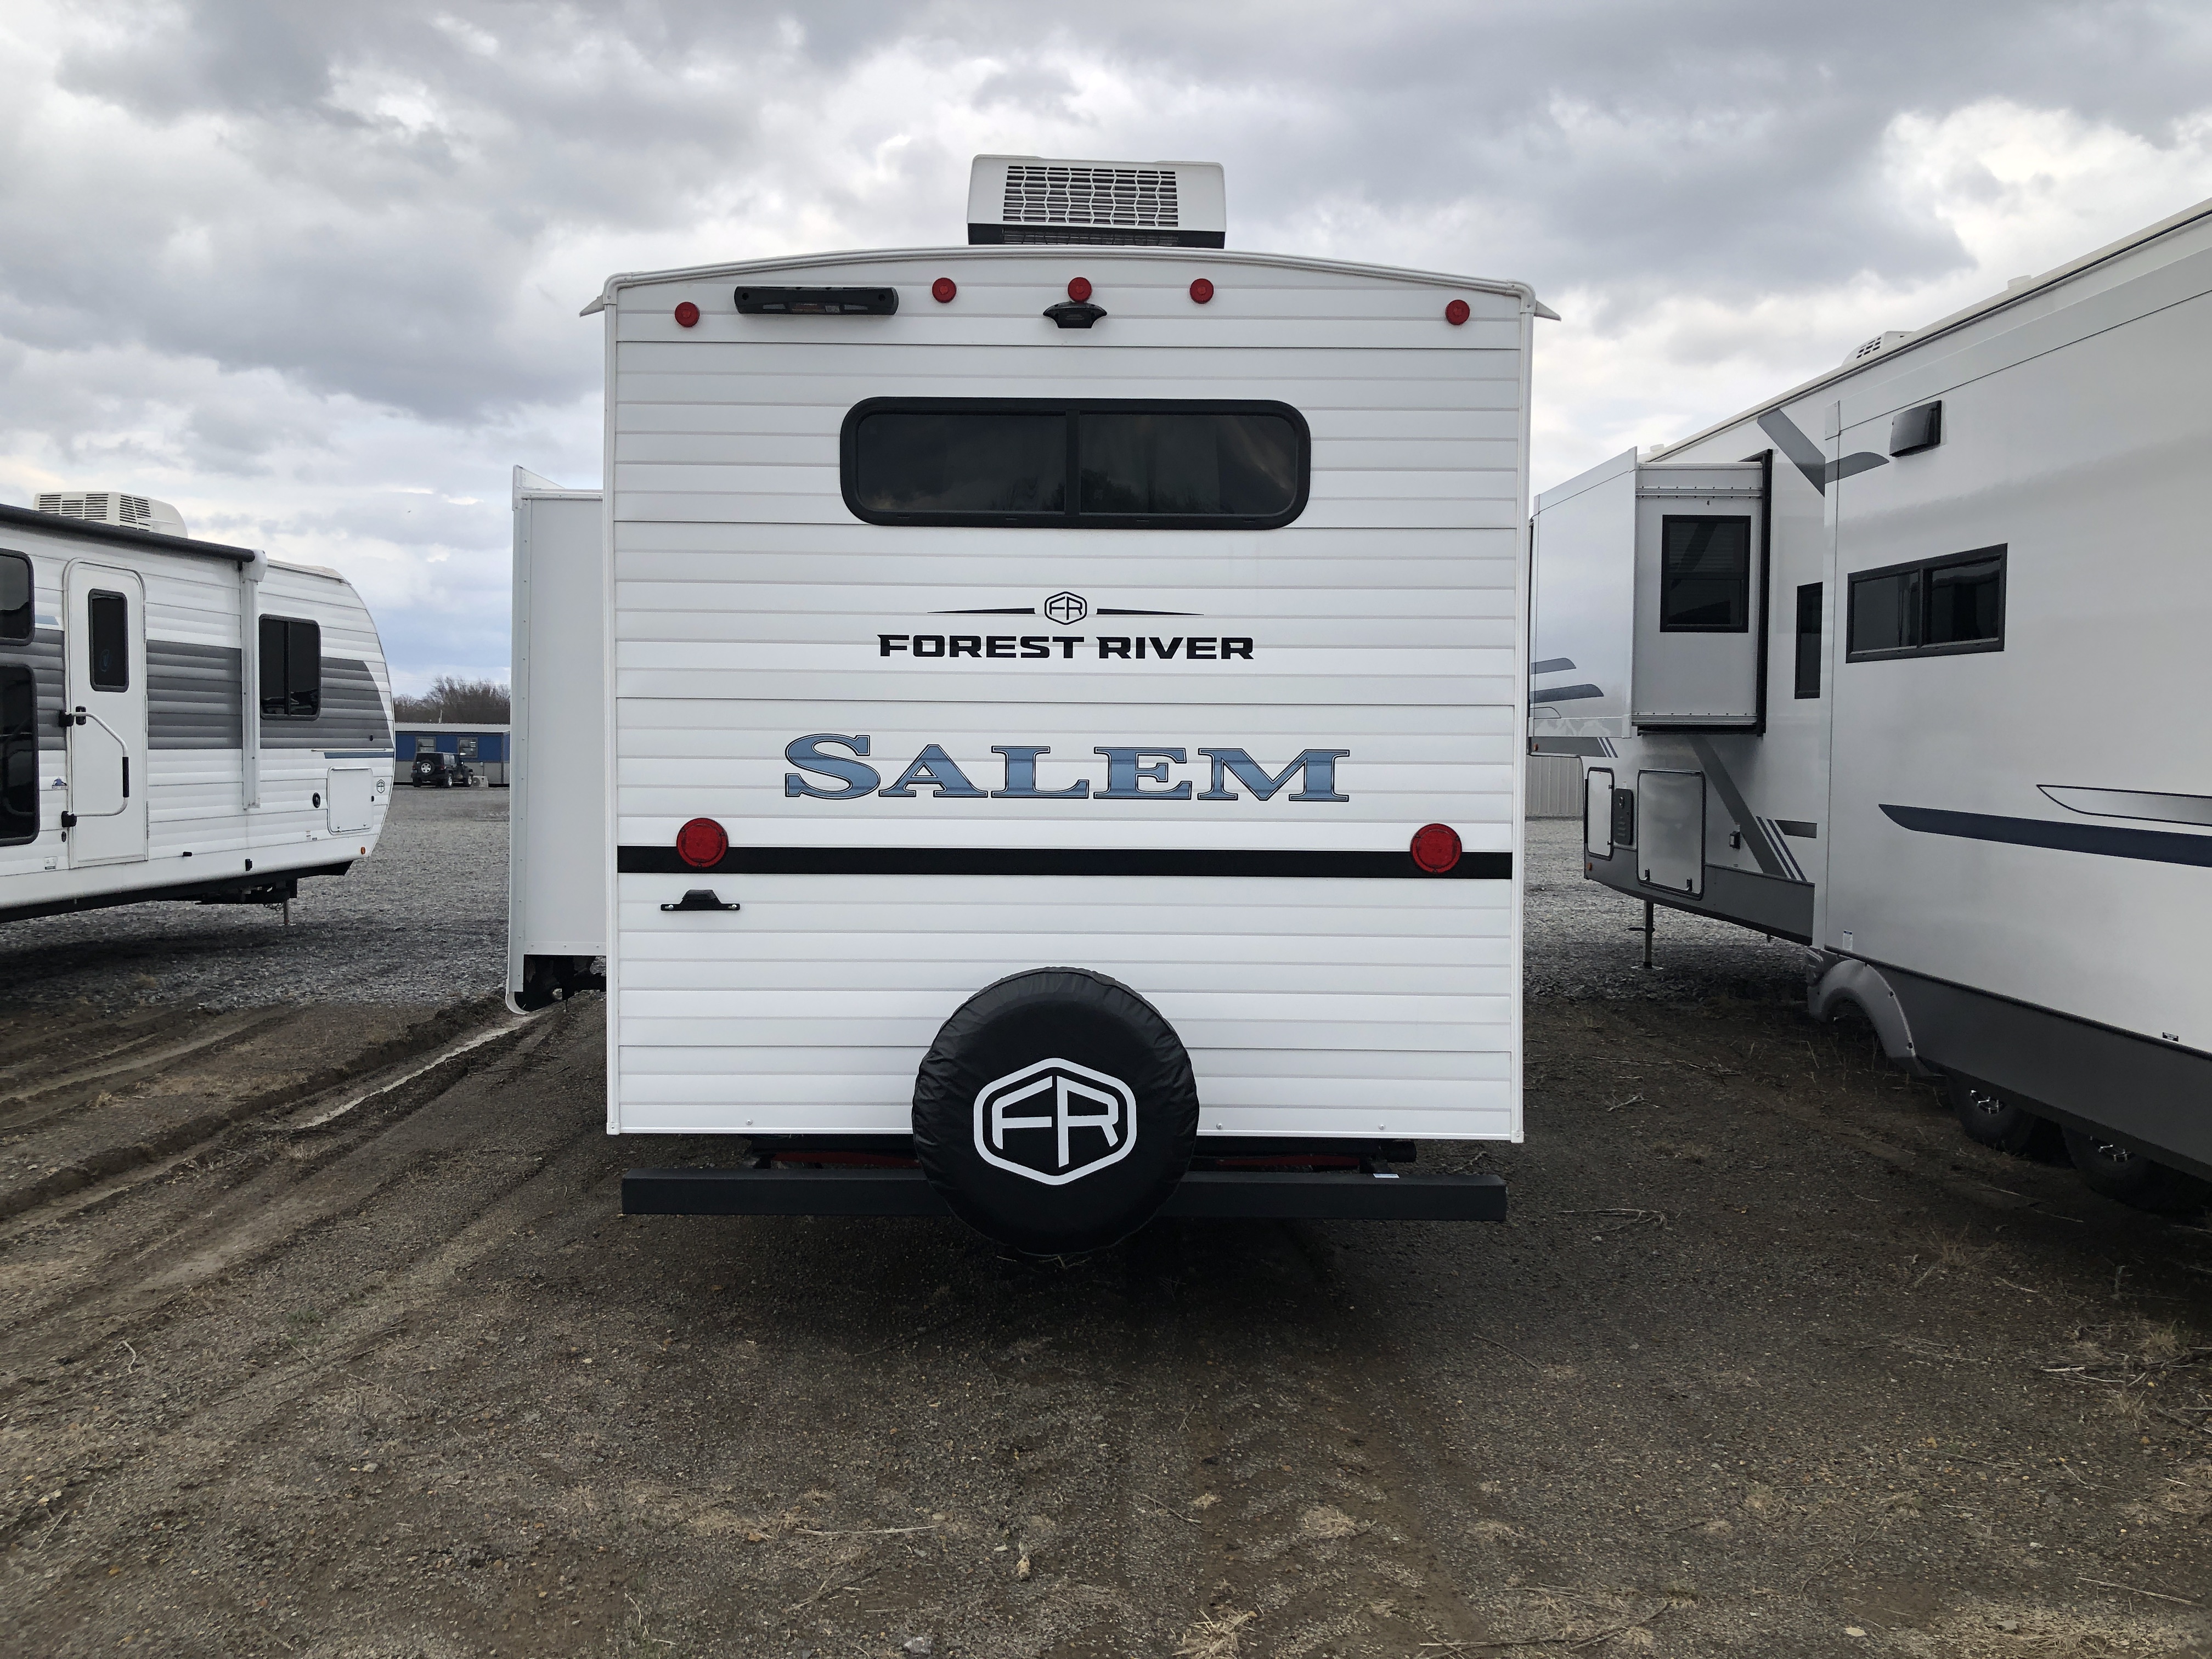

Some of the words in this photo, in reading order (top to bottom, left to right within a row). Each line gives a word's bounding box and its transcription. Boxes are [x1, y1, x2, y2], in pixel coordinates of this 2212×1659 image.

[1049, 596, 1083, 620] FR
[877, 634, 1085, 659] FOREST
[1096, 636, 1254, 659] RIVER
[785, 733, 1351, 803] SALEM
[992, 1075, 1119, 1168] FR
